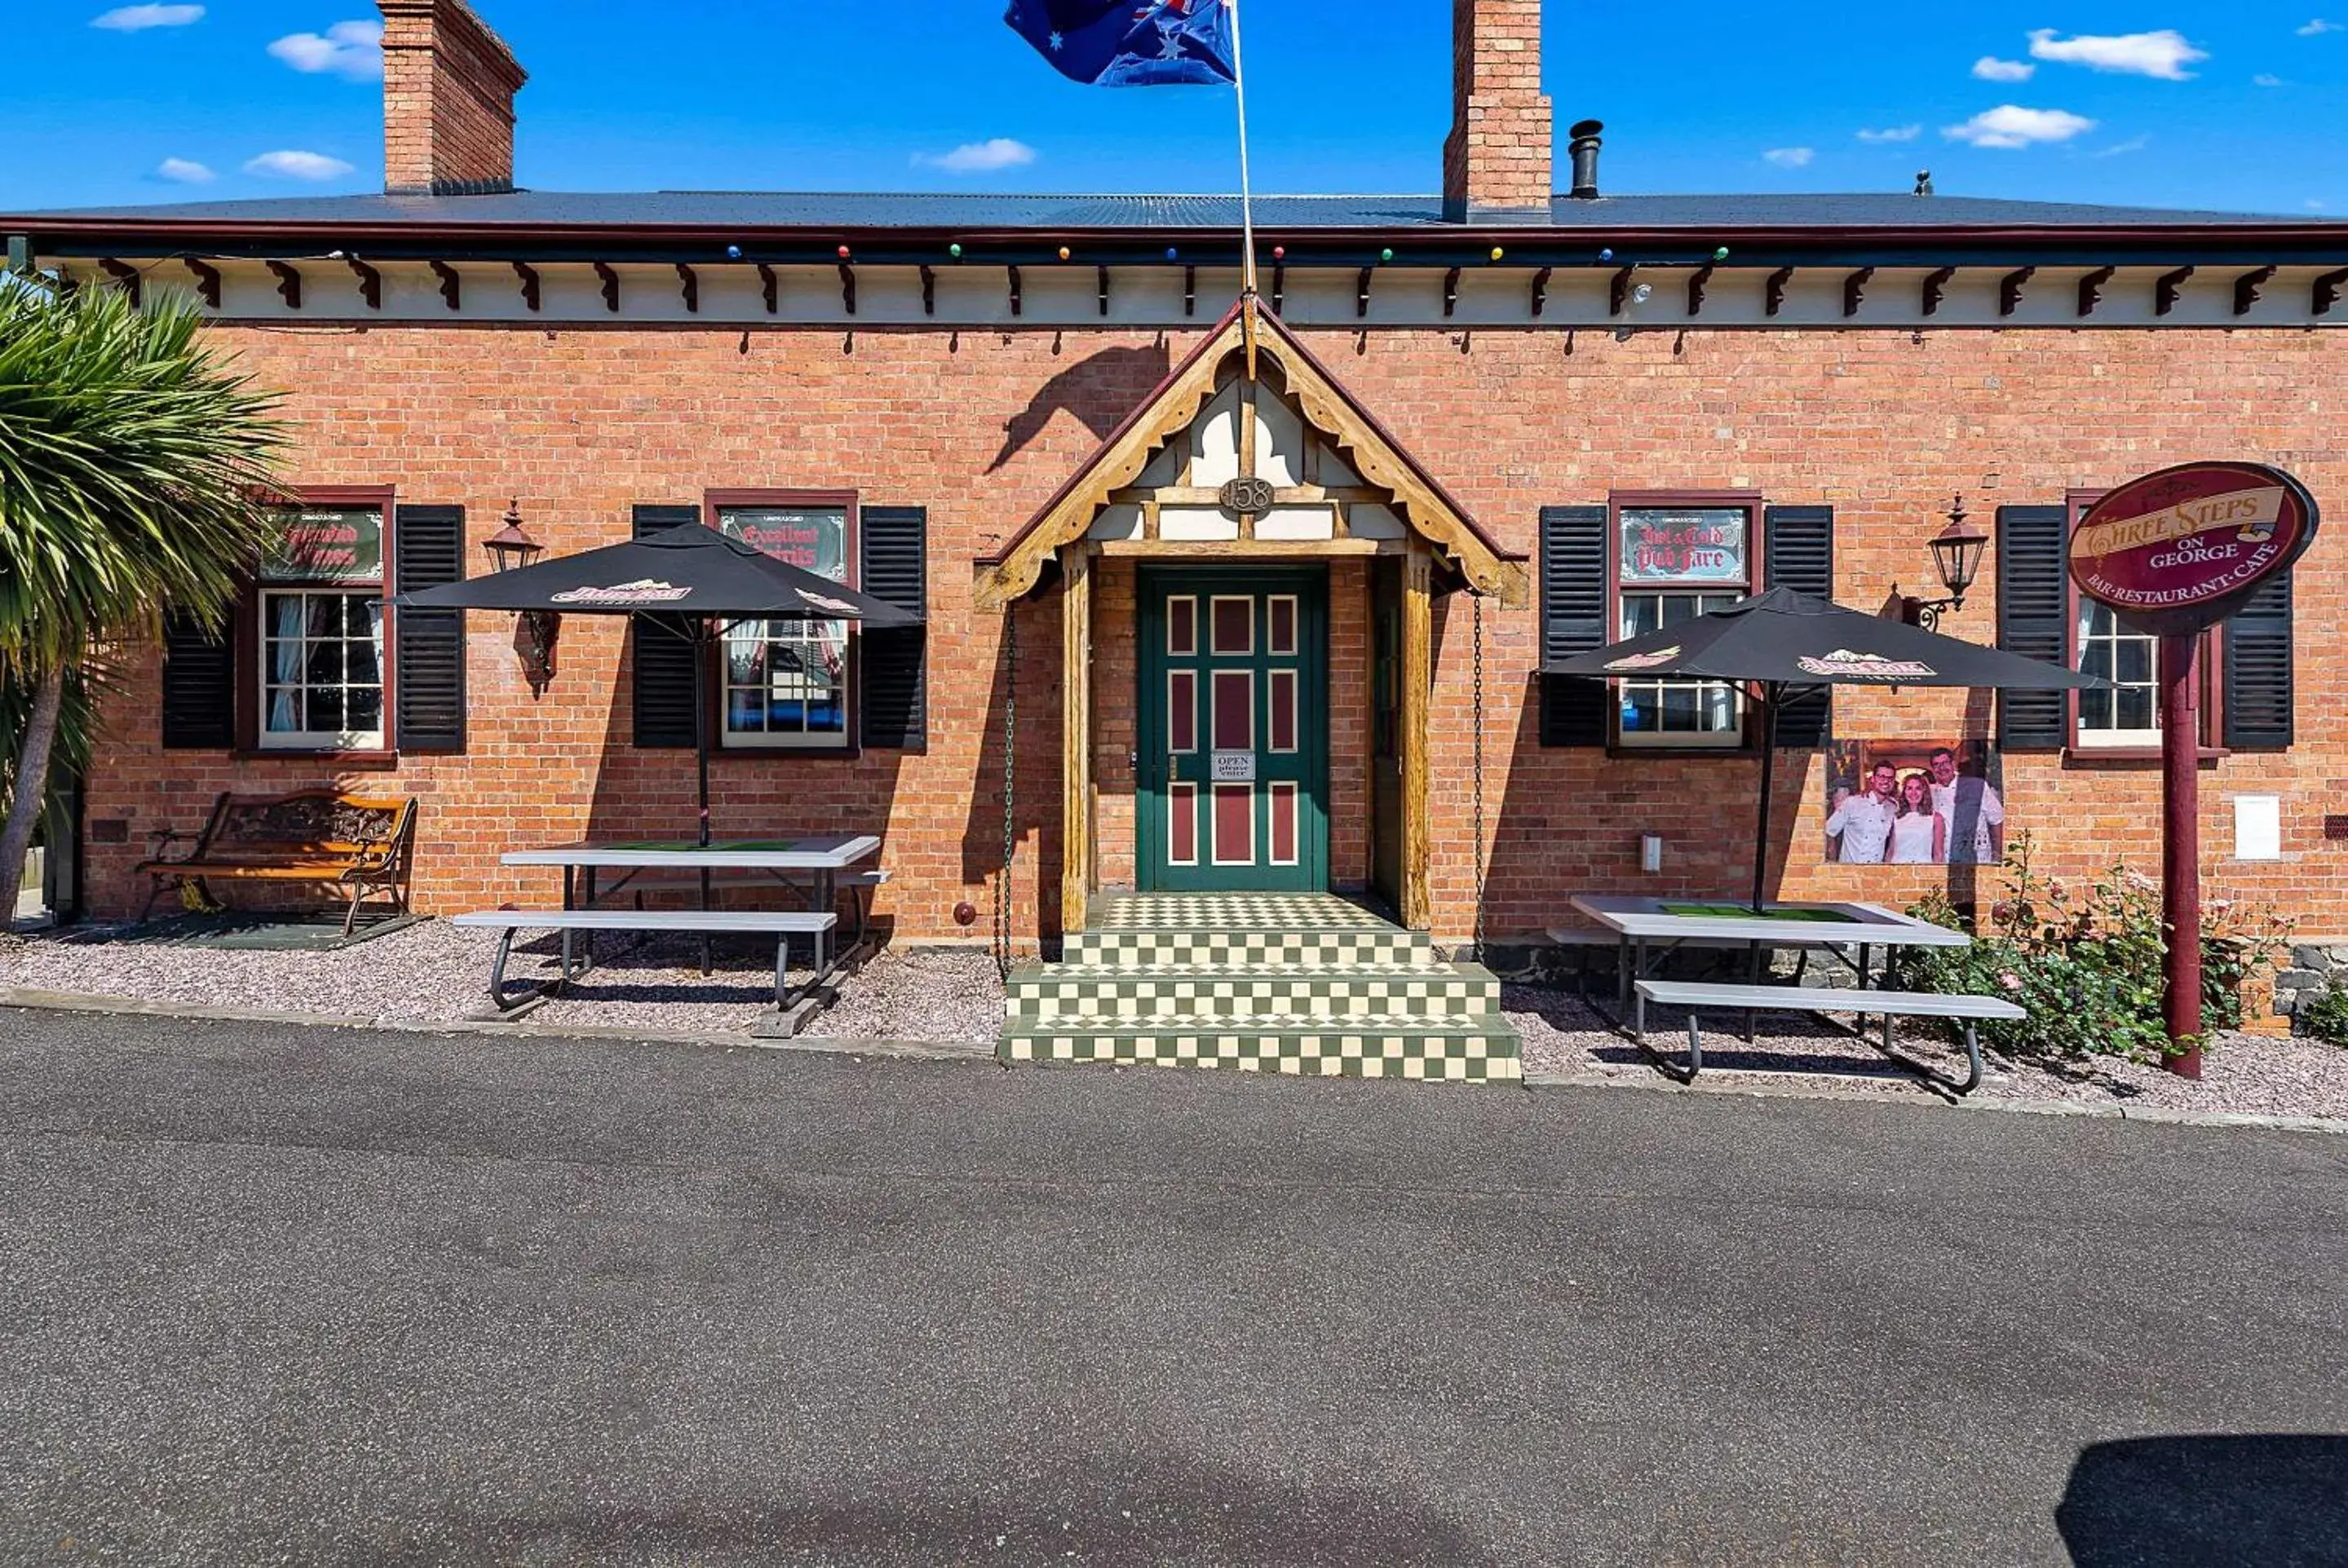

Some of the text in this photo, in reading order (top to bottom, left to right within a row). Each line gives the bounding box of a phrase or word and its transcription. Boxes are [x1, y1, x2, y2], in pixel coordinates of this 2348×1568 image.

[2173, 496, 2257, 536] STEPS
[2150, 543, 2240, 568] GEORGE
[2178, 536, 2204, 550] ON
[1637, 545, 1723, 572] Pub Fare
[1218, 757, 1249, 765] OPEN
